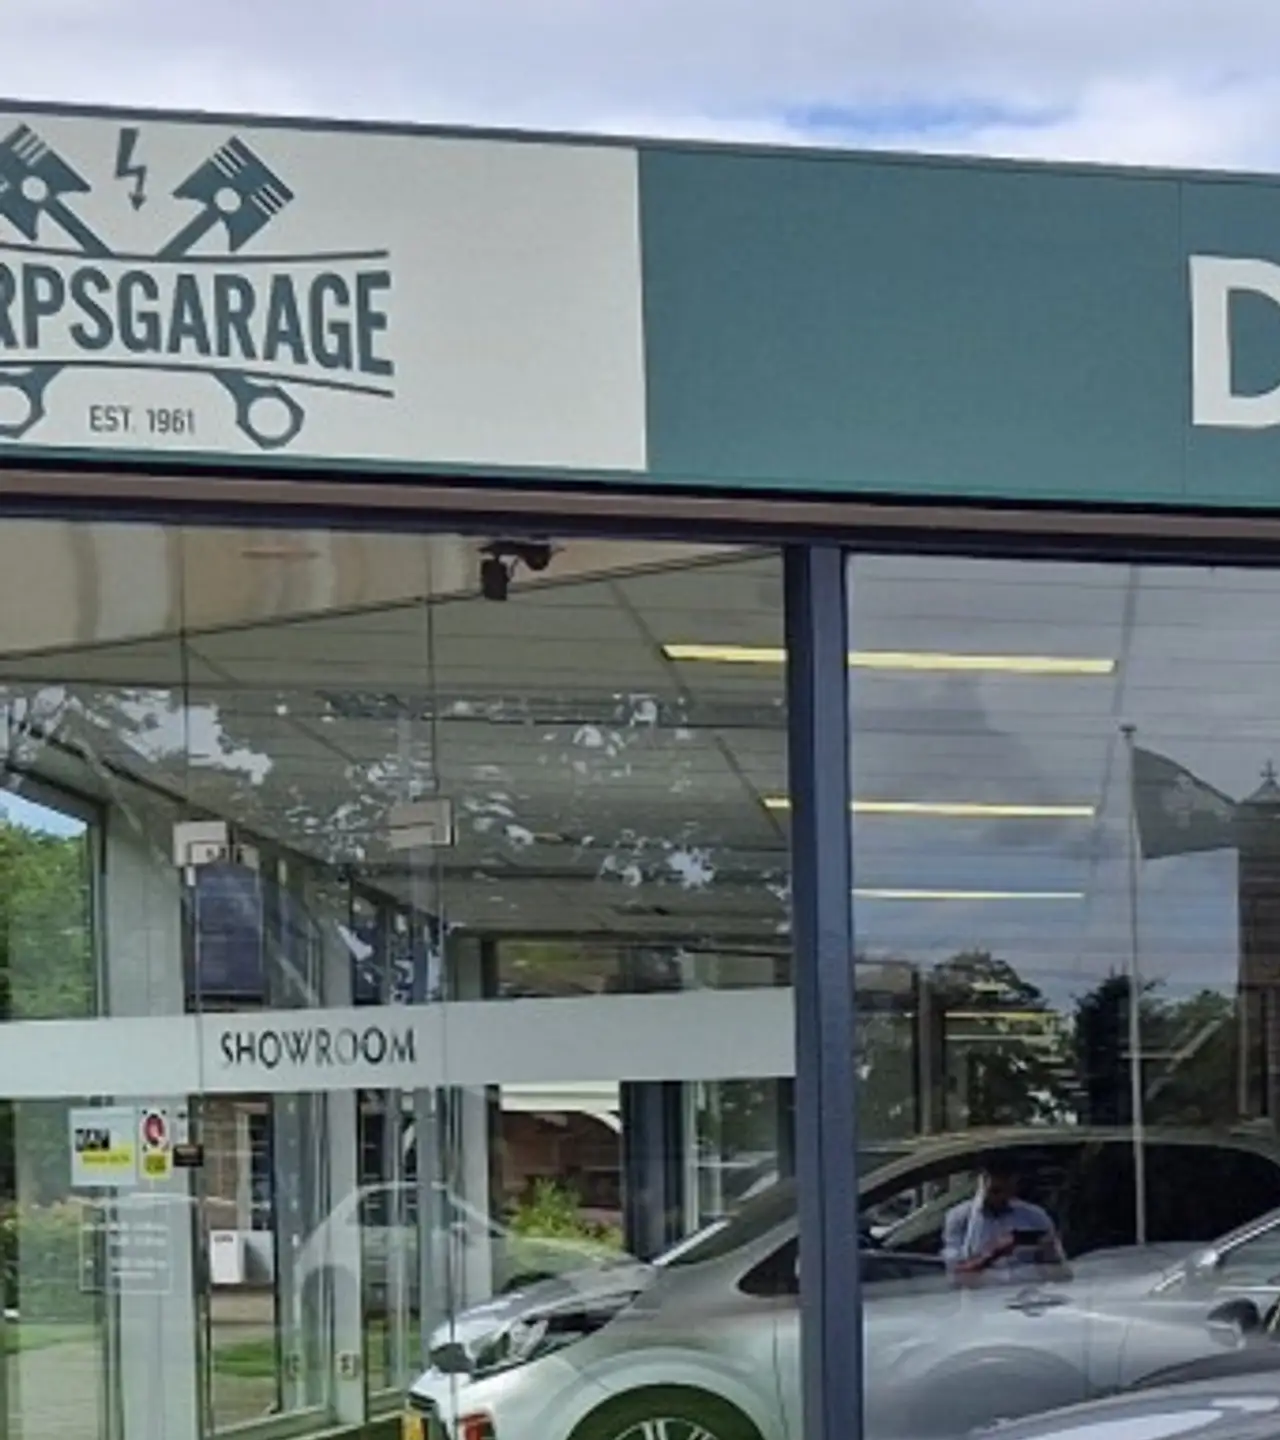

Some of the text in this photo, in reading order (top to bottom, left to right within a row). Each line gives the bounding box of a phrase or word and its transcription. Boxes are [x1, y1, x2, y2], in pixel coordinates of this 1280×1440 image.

[88, 404, 196, 435] EST. 1961
[221, 1026, 416, 1069] SHOWROOM
